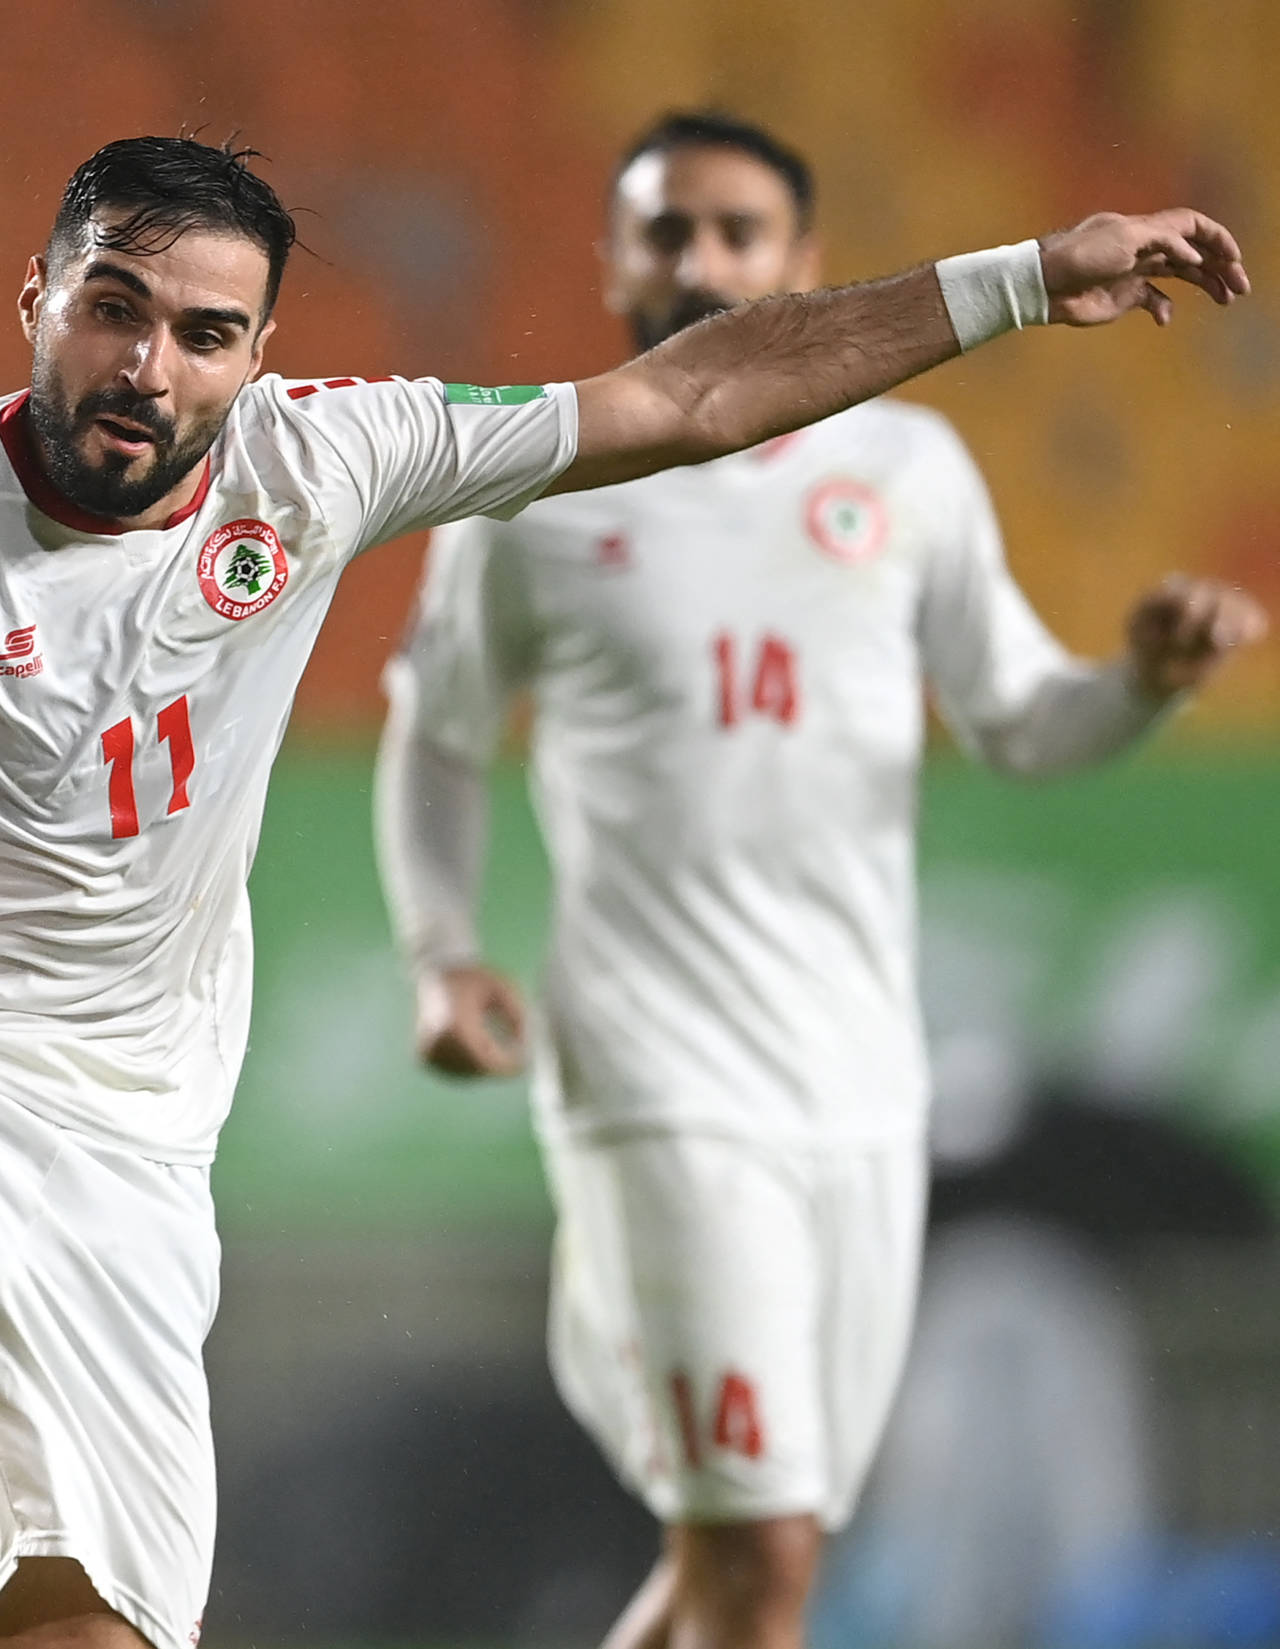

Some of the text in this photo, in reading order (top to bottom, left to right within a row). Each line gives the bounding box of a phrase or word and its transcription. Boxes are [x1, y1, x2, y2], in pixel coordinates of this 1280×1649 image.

[216, 592, 273, 617] LEBANON
[710, 630, 799, 729] 14
[101, 694, 196, 840] 11
[668, 1369, 762, 1470] 14
